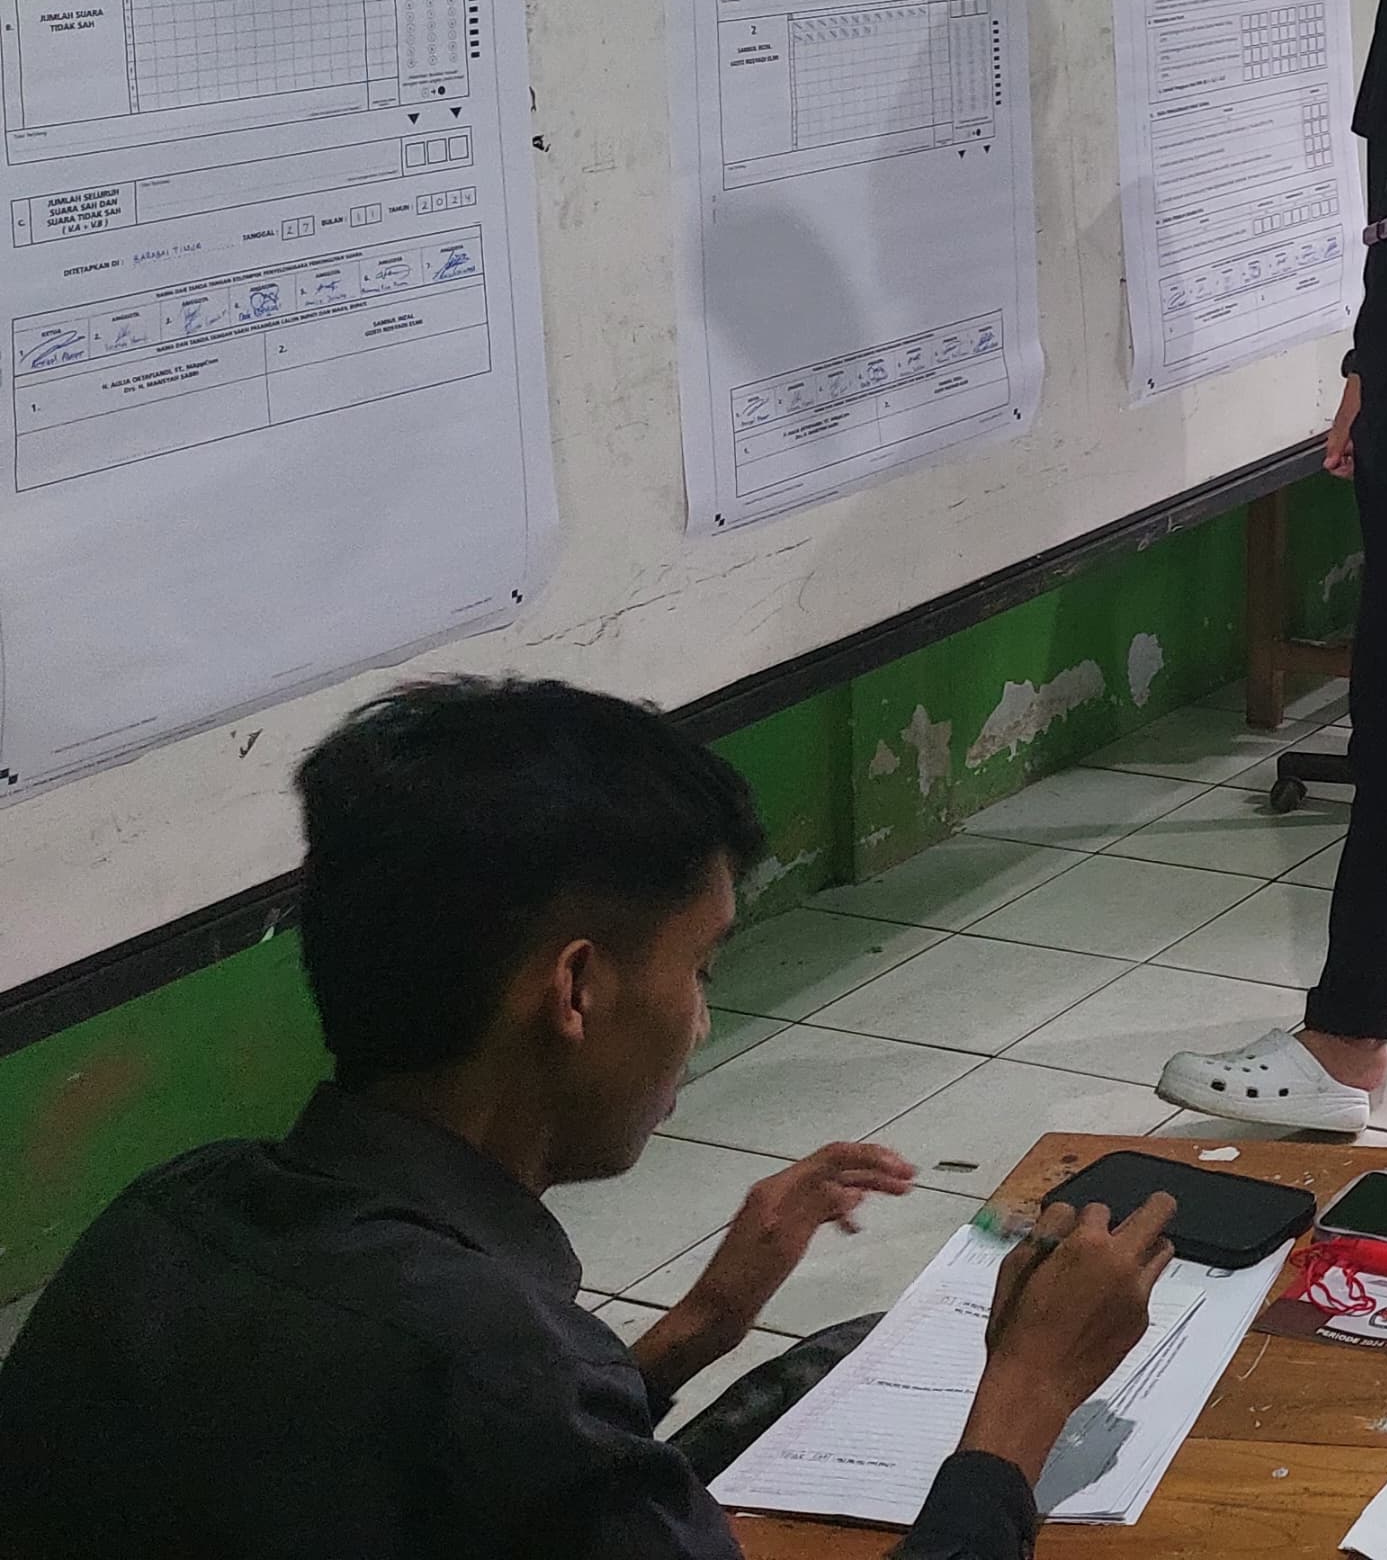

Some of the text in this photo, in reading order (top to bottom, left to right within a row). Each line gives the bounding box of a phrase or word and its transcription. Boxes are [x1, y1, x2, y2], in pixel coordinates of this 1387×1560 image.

[40, 9, 104, 22] JUMLAH SUARA
[49, 20, 95, 32] TIDAK SAH
[48, 189, 120, 207] JUMLAH SELURUH
[49, 198, 118, 217] SUARA SAH DAN
[388, 203, 410, 214] TAHUN
[47, 207, 121, 227] SUARA TIDAK SAH
[321, 216, 344, 227] BULAN
[63, 262, 110, 277] DITETAPKAN
[1315, 1328, 1362, 1345] PERIODE
